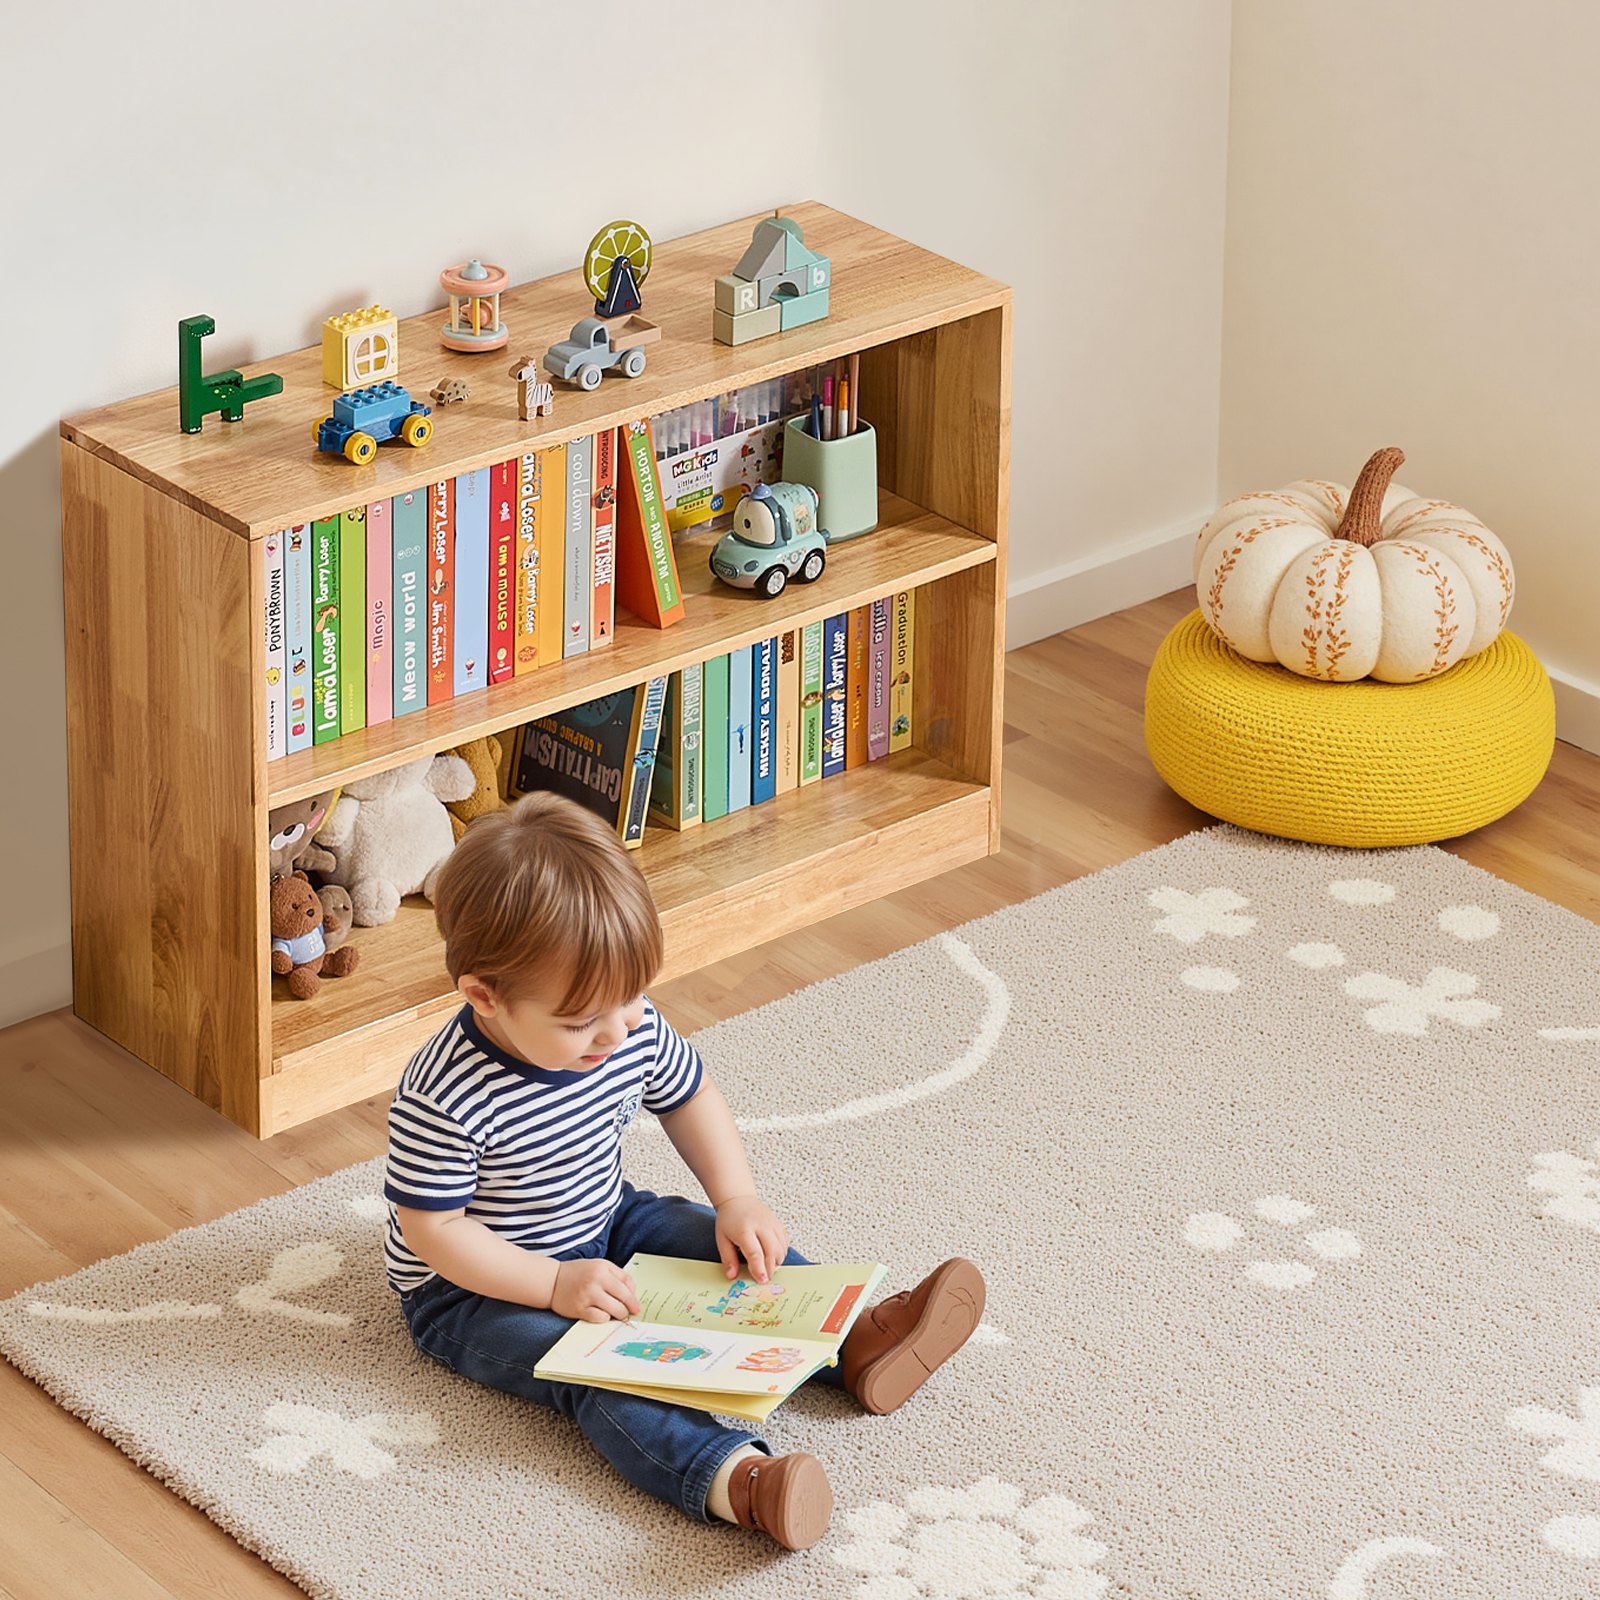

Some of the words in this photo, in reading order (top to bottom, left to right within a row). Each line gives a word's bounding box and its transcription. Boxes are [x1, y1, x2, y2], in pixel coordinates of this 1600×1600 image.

[813, 266, 826, 288] b
[740, 288, 754, 310] R
[521, 453, 536, 482] am
[572, 453, 590, 487] cool
[600, 431, 608, 479] INTRODUCING
[521, 484, 536, 496] a
[677, 475, 694, 489] Little
[694, 471, 712, 483] Artist
[435, 480, 448, 518] arry
[572, 488, 589, 533] down
[636, 447, 655, 503] HORTON
[650, 522, 670, 580] ANONYM
[520, 495, 540, 542] Loser
[318, 536, 330, 568] Loser
[435, 520, 448, 564] Loser
[498, 535, 511, 544] I
[498, 544, 508, 566] am
[594, 524, 612, 588] NIETZSCHE
[314, 569, 330, 604] Barry
[498, 568, 507, 578] a
[526, 568, 540, 602] Barry
[269, 568, 282, 652] PONYBROWN
[402, 570, 417, 632] world
[431, 600, 444, 626] Jim
[497, 579, 508, 631] mouse
[372, 600, 386, 650] Magic
[526, 604, 537, 634] Loser
[874, 600, 888, 644] anilla
[898, 592, 908, 666] Graduation
[316, 628, 338, 678] Loser
[431, 626, 444, 669] Smith
[804, 622, 820, 684] PHILOSOPH
[830, 630, 846, 659] Loser
[875, 650, 885, 668] ice
[324, 674, 337, 688] a
[402, 641, 417, 702] Meow
[826, 658, 846, 690] Barry
[323, 688, 337, 720] am
[642, 676, 666, 730] CAPITALIS
[684, 664, 700, 724] PSYCHOLOG
[874, 670, 884, 708] cream
[760, 700, 770, 716] &
[824, 702, 845, 734] Loser
[317, 720, 337, 732] I
[560, 725, 594, 752] GRAPHIC
[832, 729, 844, 738] a
[524, 728, 622, 802] CAPITALISM
[596, 743, 602, 756] A
[760, 718, 770, 778] MICKEY
[824, 757, 844, 768] I
[831, 738, 844, 758] am
